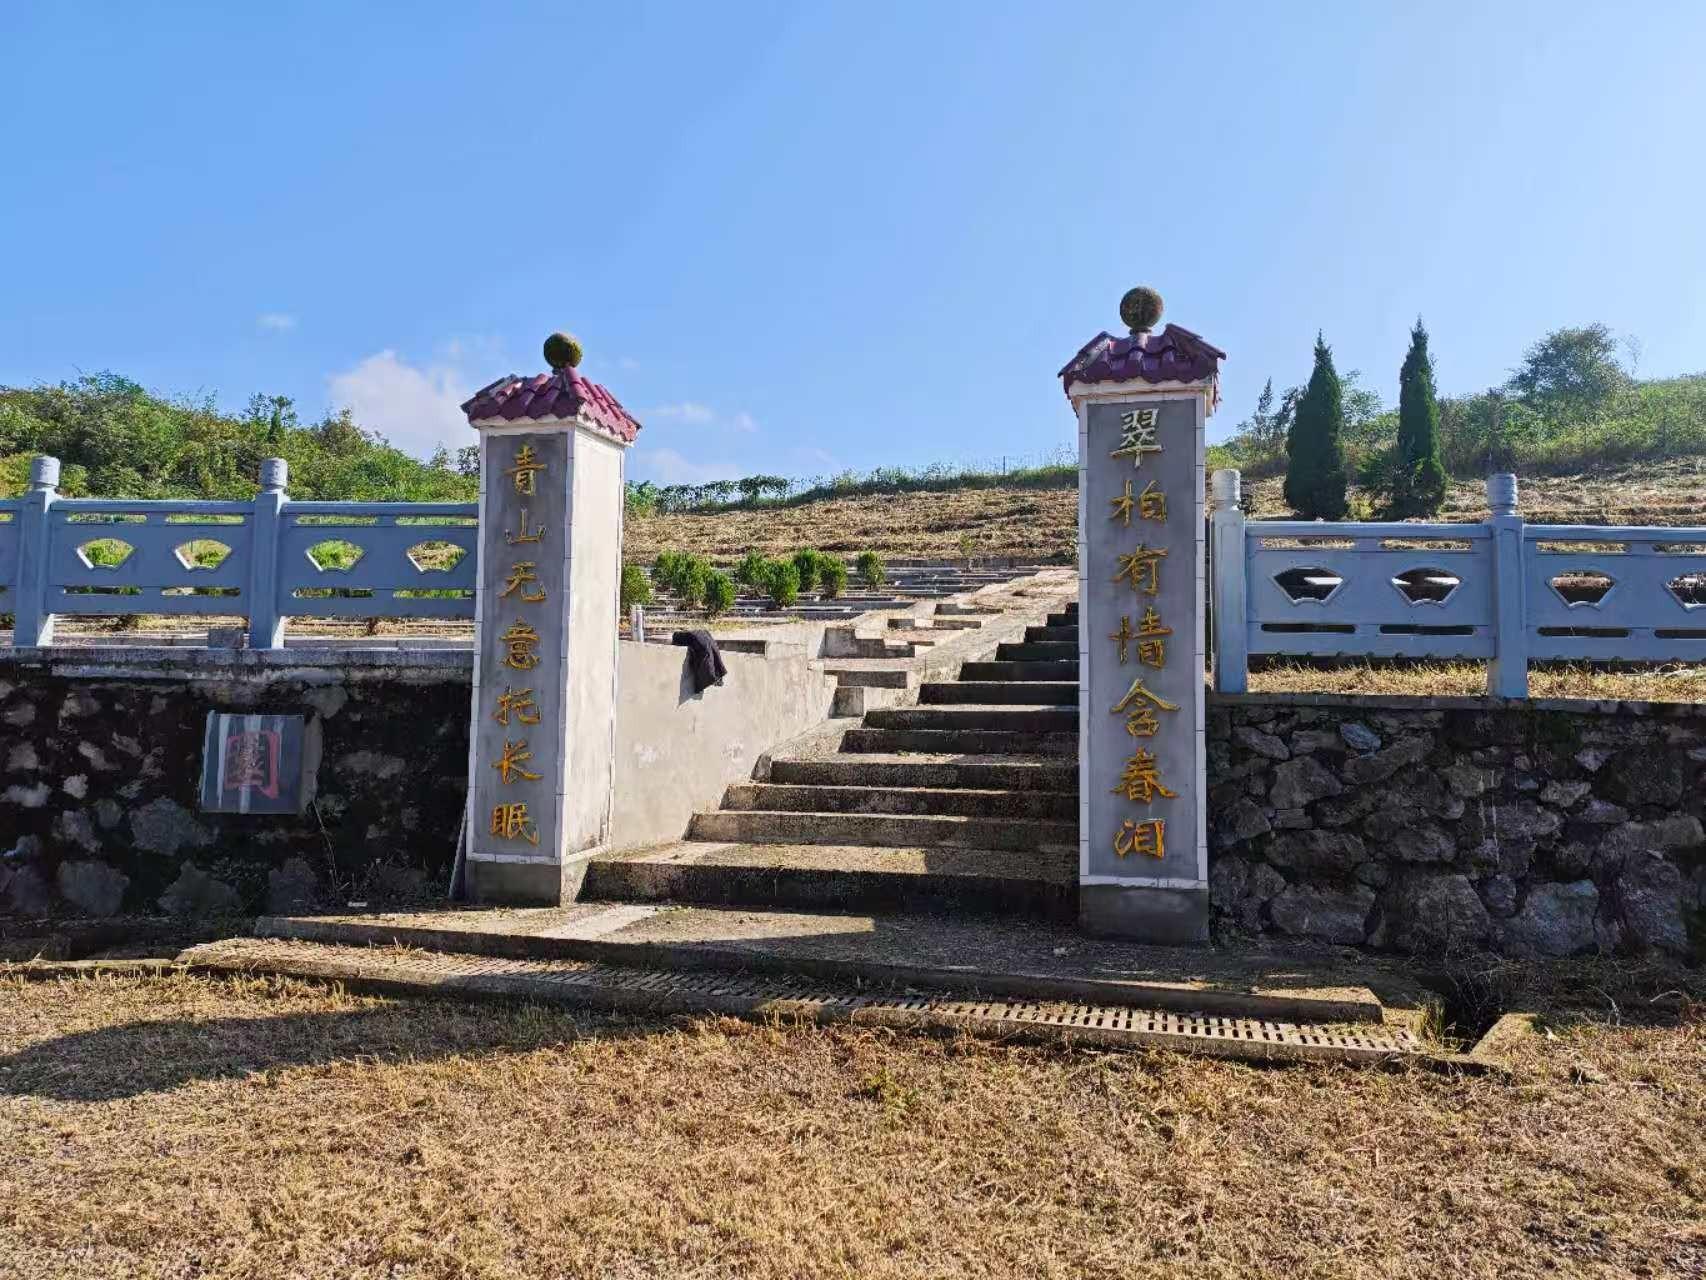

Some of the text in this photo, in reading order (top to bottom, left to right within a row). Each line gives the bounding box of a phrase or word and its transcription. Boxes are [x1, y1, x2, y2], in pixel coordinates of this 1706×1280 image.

[490, 444, 546, 846] 青山无意托长眠
[1109, 407, 1180, 858] 翠柏有情含春泪
